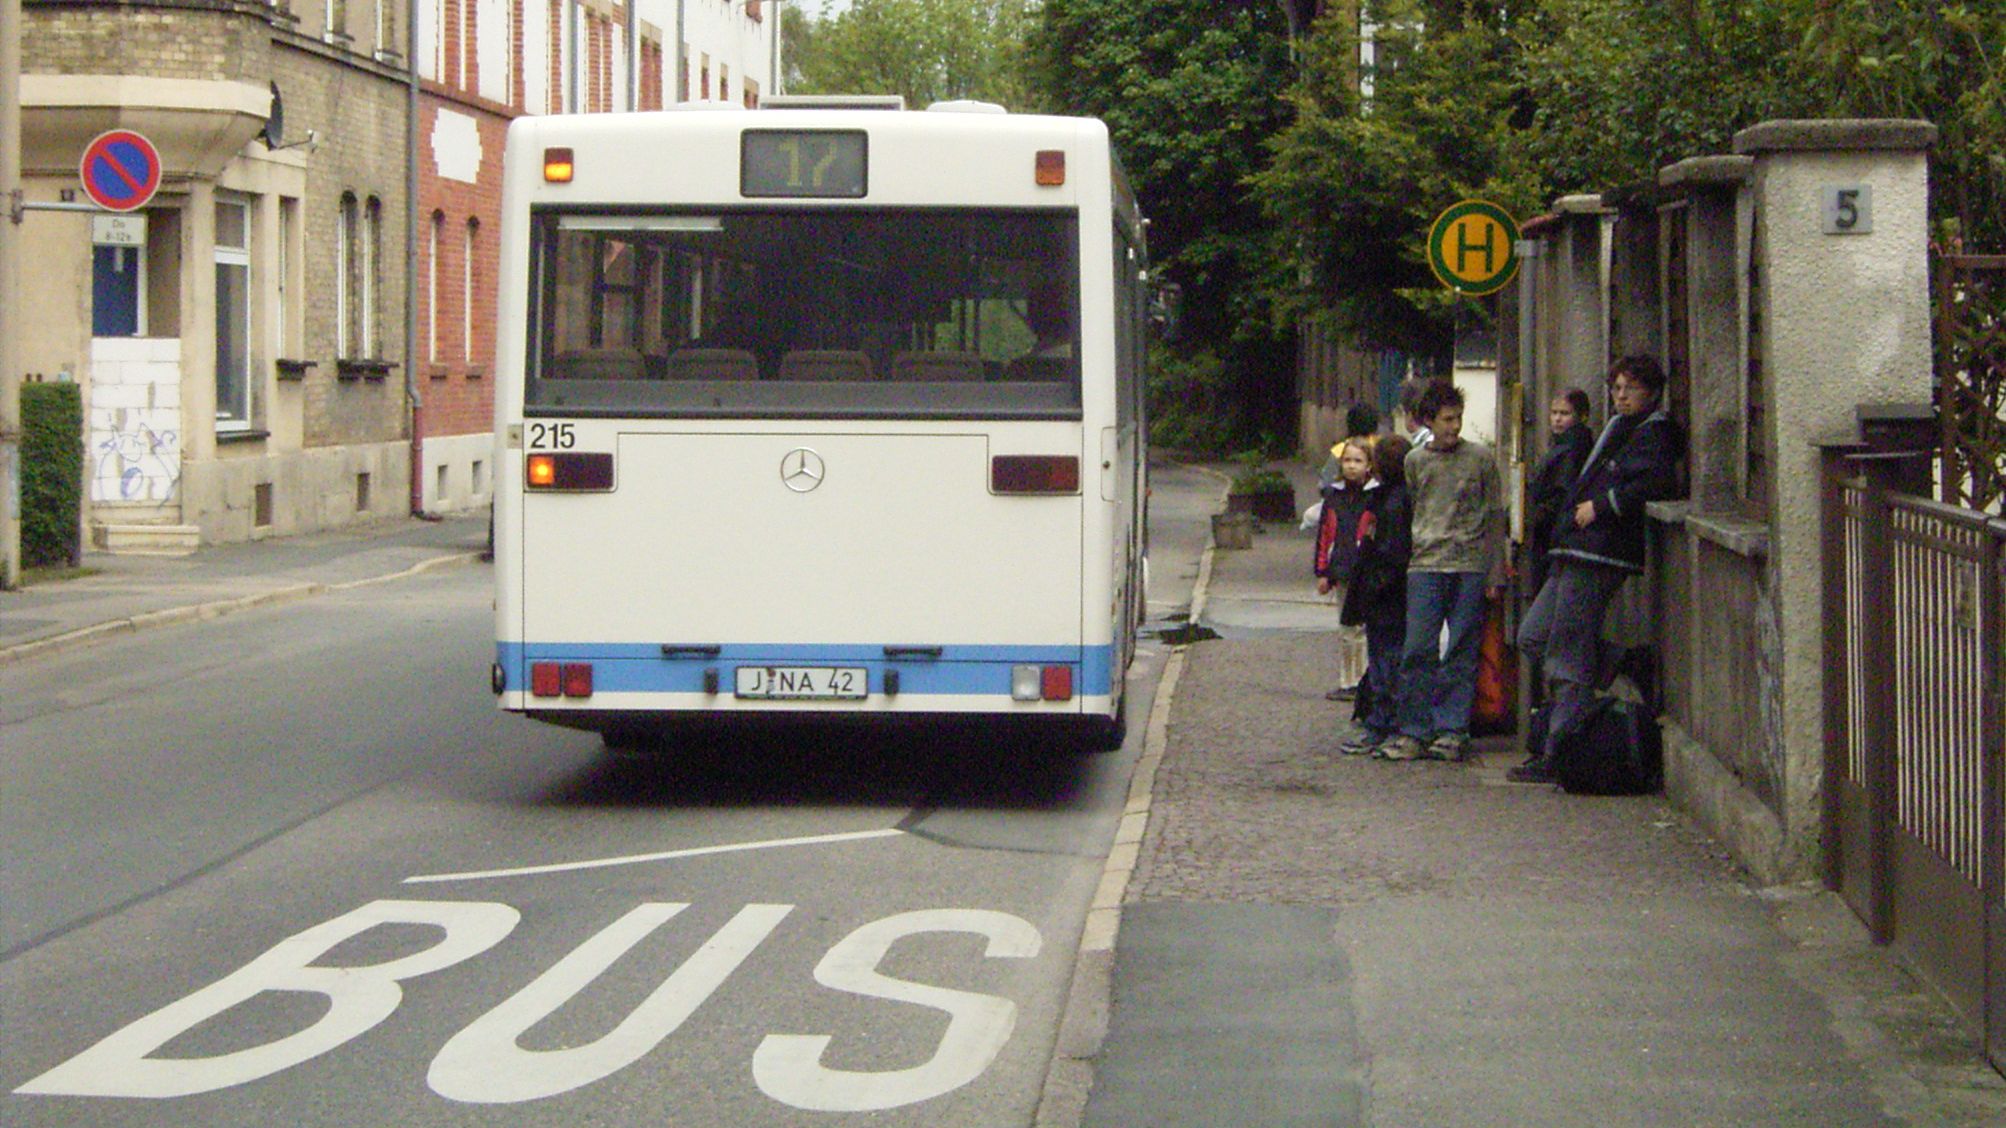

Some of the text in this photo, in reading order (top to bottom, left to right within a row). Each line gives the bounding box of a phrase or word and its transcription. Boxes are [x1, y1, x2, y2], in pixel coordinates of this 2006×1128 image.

[779, 140, 838, 187] 17
[1836, 189, 1859, 229] 5
[1457, 222, 1493, 273] H
[530, 423, 575, 448] 215
[751, 669, 853, 694] J NA 42
[13, 900, 1046, 1112] BUS
